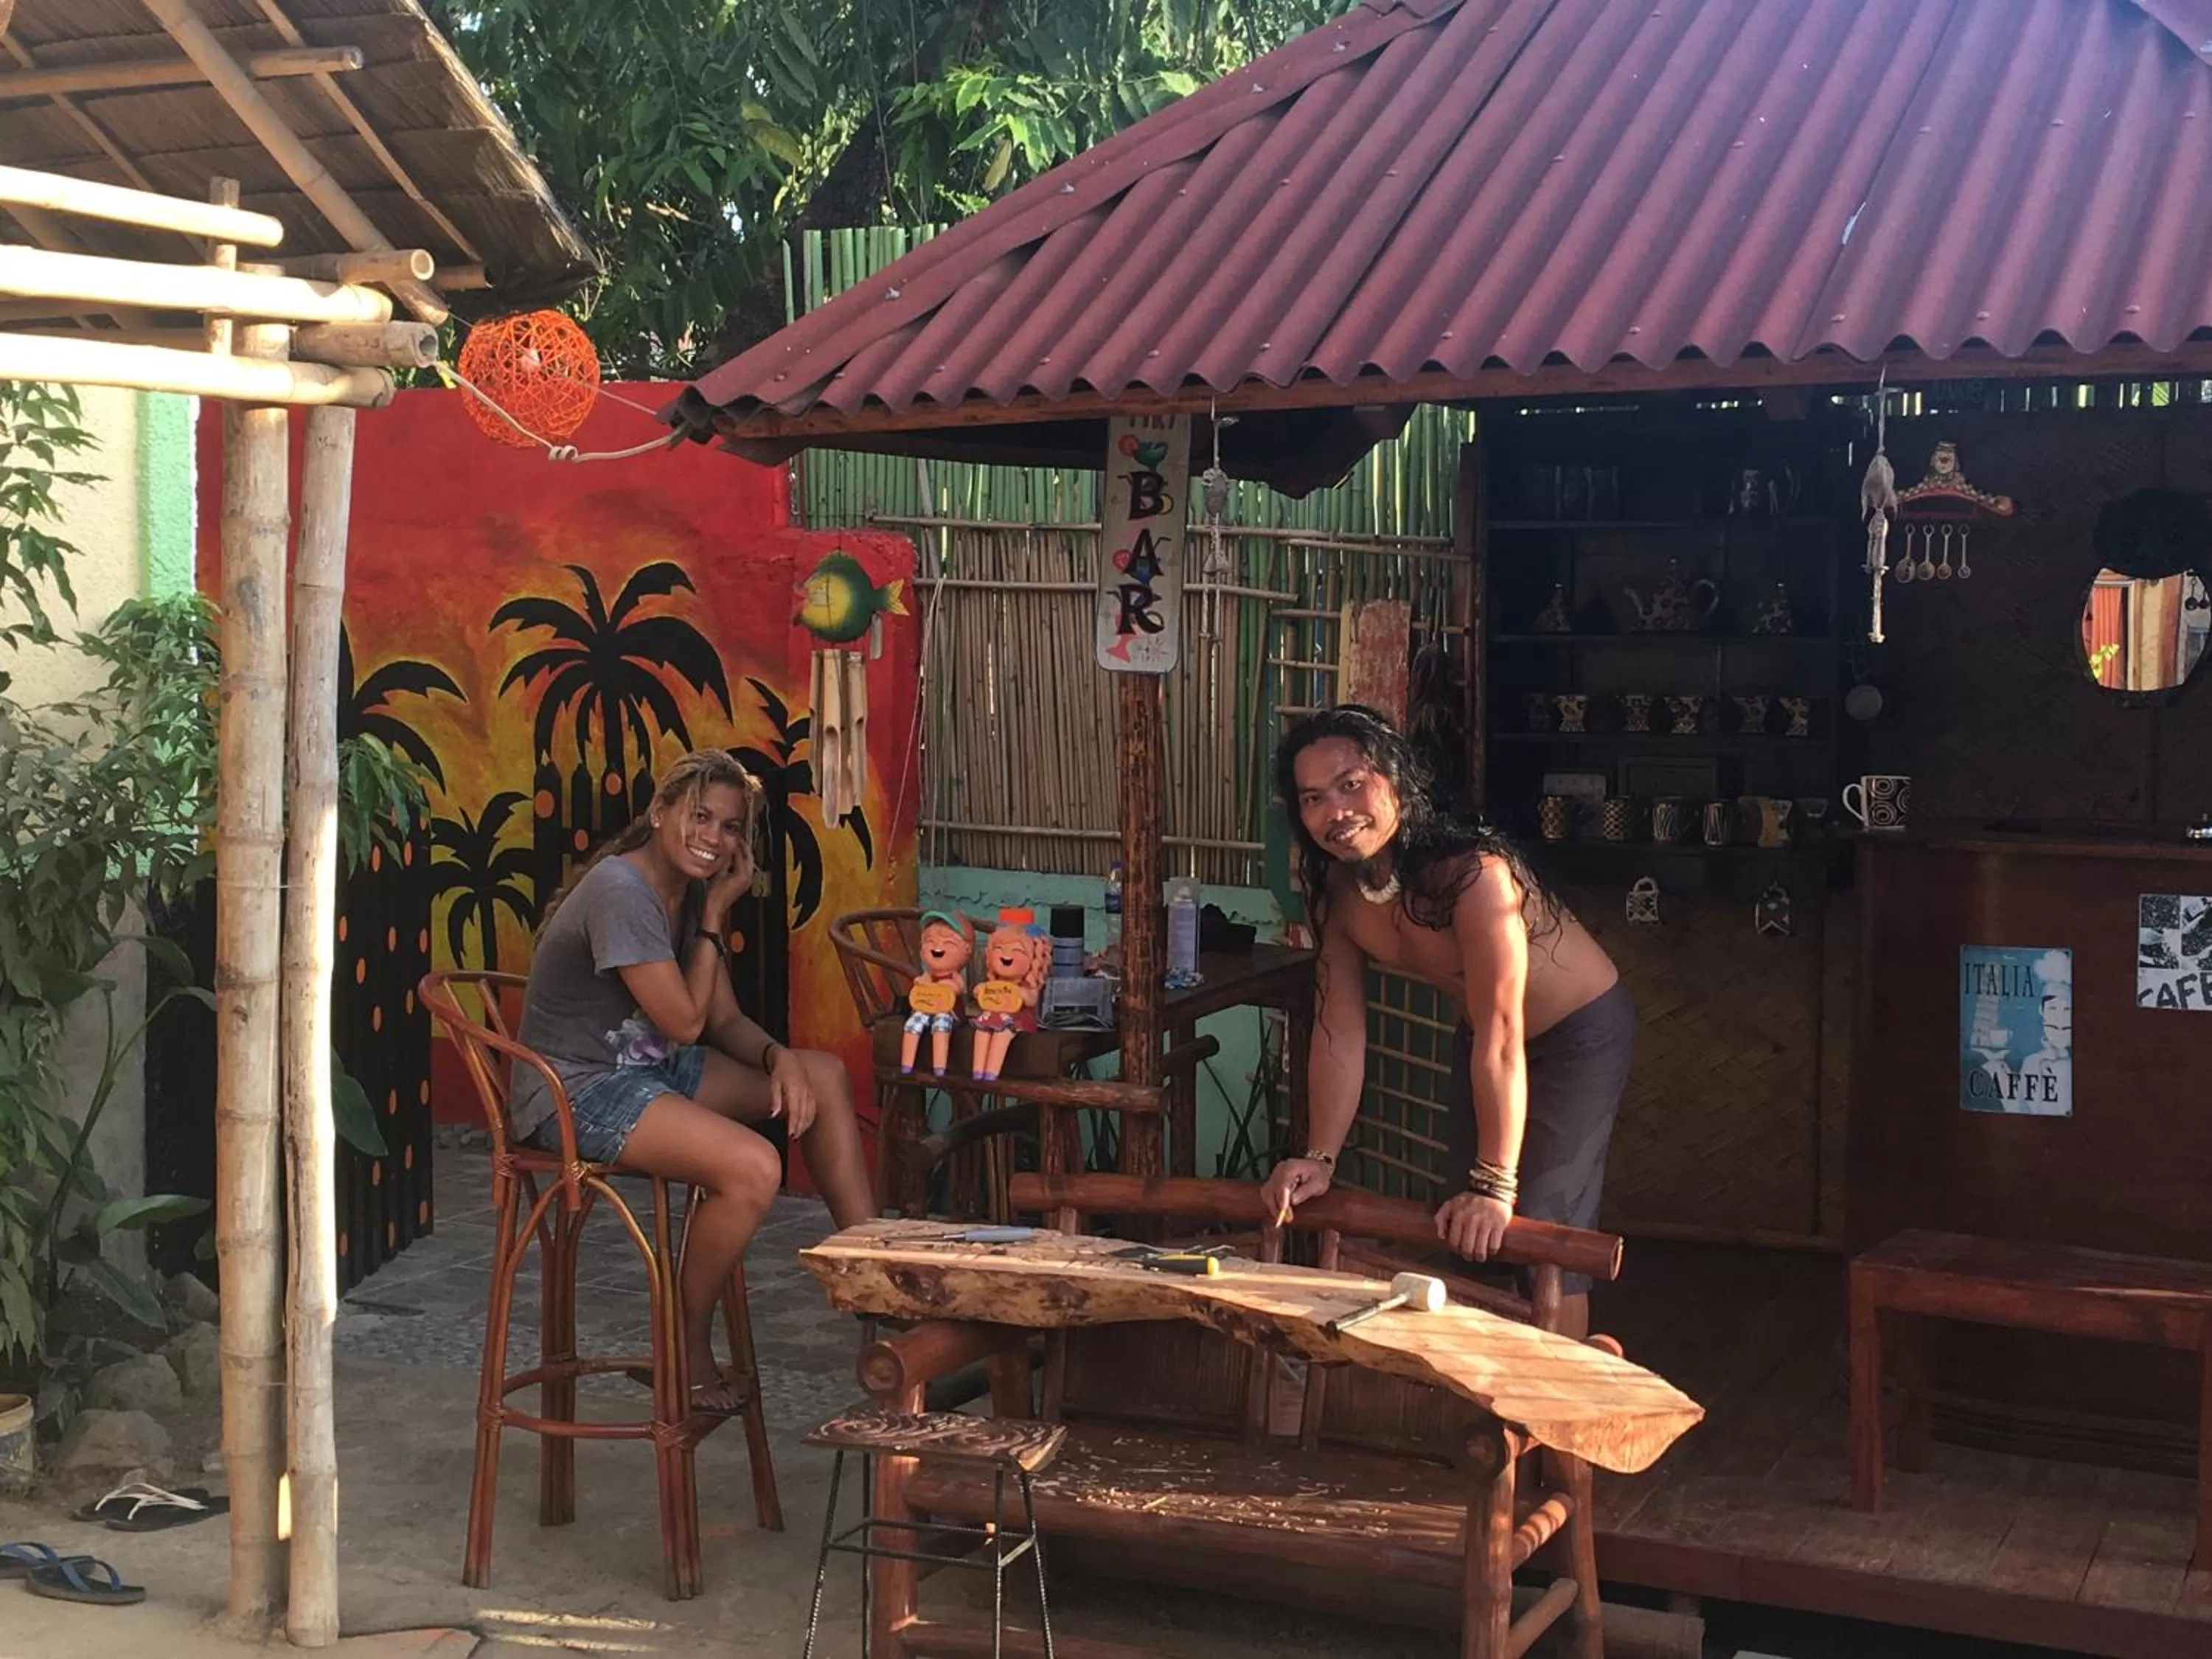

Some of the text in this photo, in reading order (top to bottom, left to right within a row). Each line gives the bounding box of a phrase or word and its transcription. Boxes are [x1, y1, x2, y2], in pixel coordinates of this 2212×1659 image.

[1112, 470, 1170, 635] BAR
[1964, 961, 2035, 998] ITALIA
[1969, 1066, 2059, 1103] CAFFÈ
